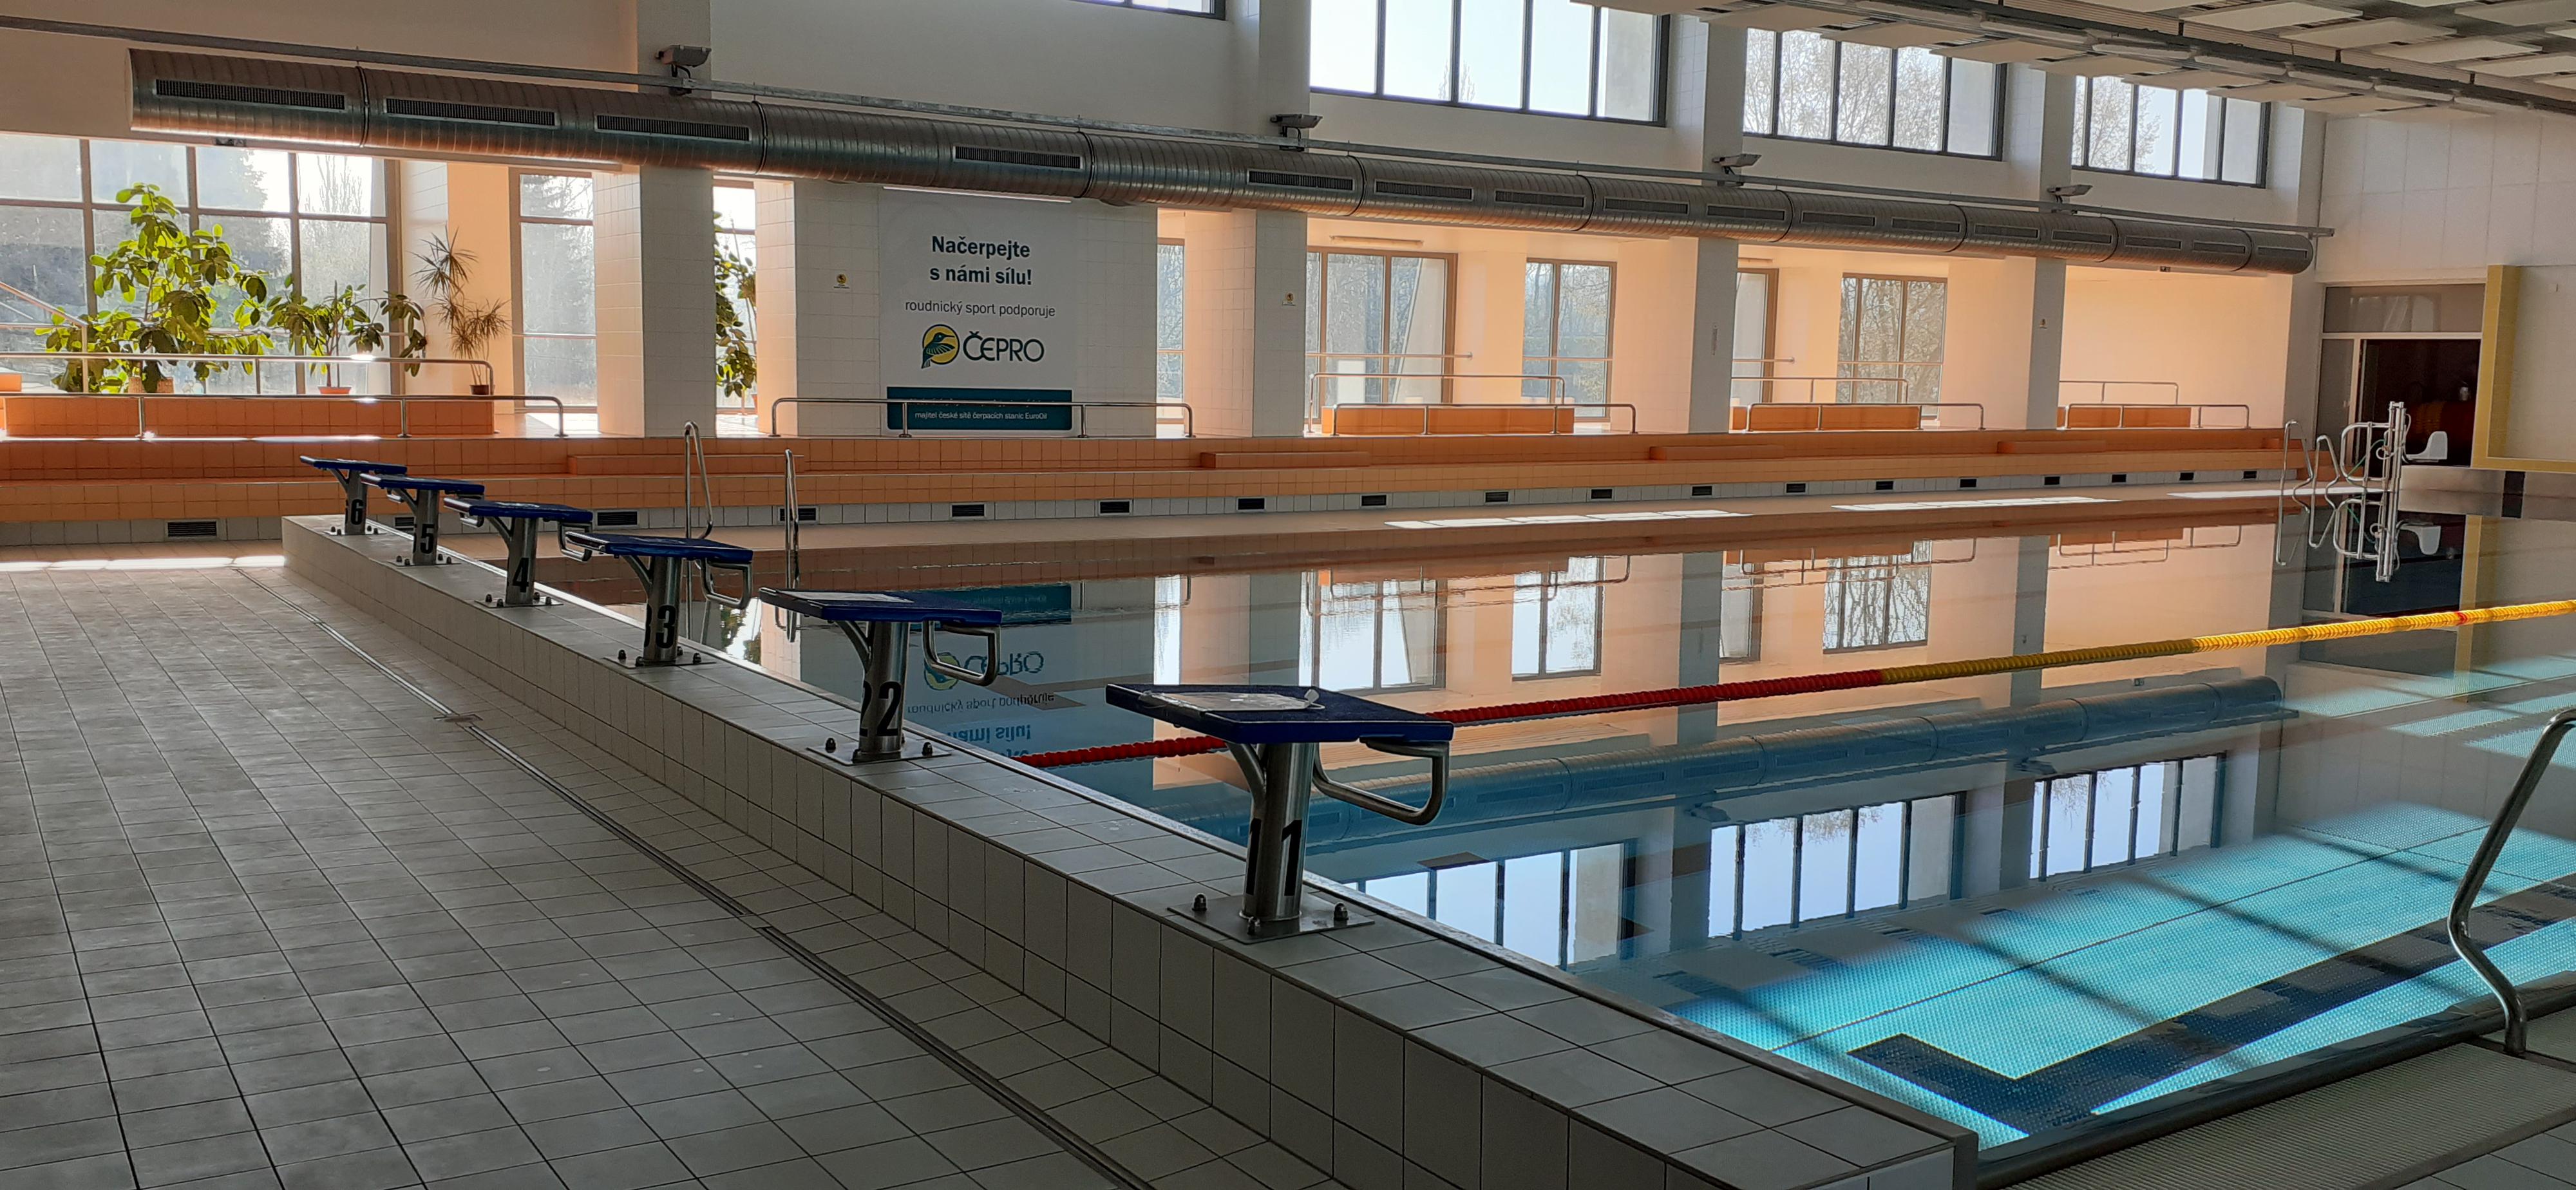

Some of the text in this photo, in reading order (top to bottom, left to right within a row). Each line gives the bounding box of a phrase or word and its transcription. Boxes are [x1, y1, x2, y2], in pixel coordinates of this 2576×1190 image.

[932, 236, 1030, 260] Načerpejte
[929, 265, 1032, 285] s námi sílu!
[905, 300, 1056, 318] roudnický sport podporuje
[963, 330, 1045, 363] ČEPRO
[351, 499, 363, 525] 6
[421, 524, 434, 554] 5
[513, 558, 529, 593] 4
[656, 605, 676, 648] 3
[878, 681, 902, 737] 2
[1282, 820, 1302, 896] 1
